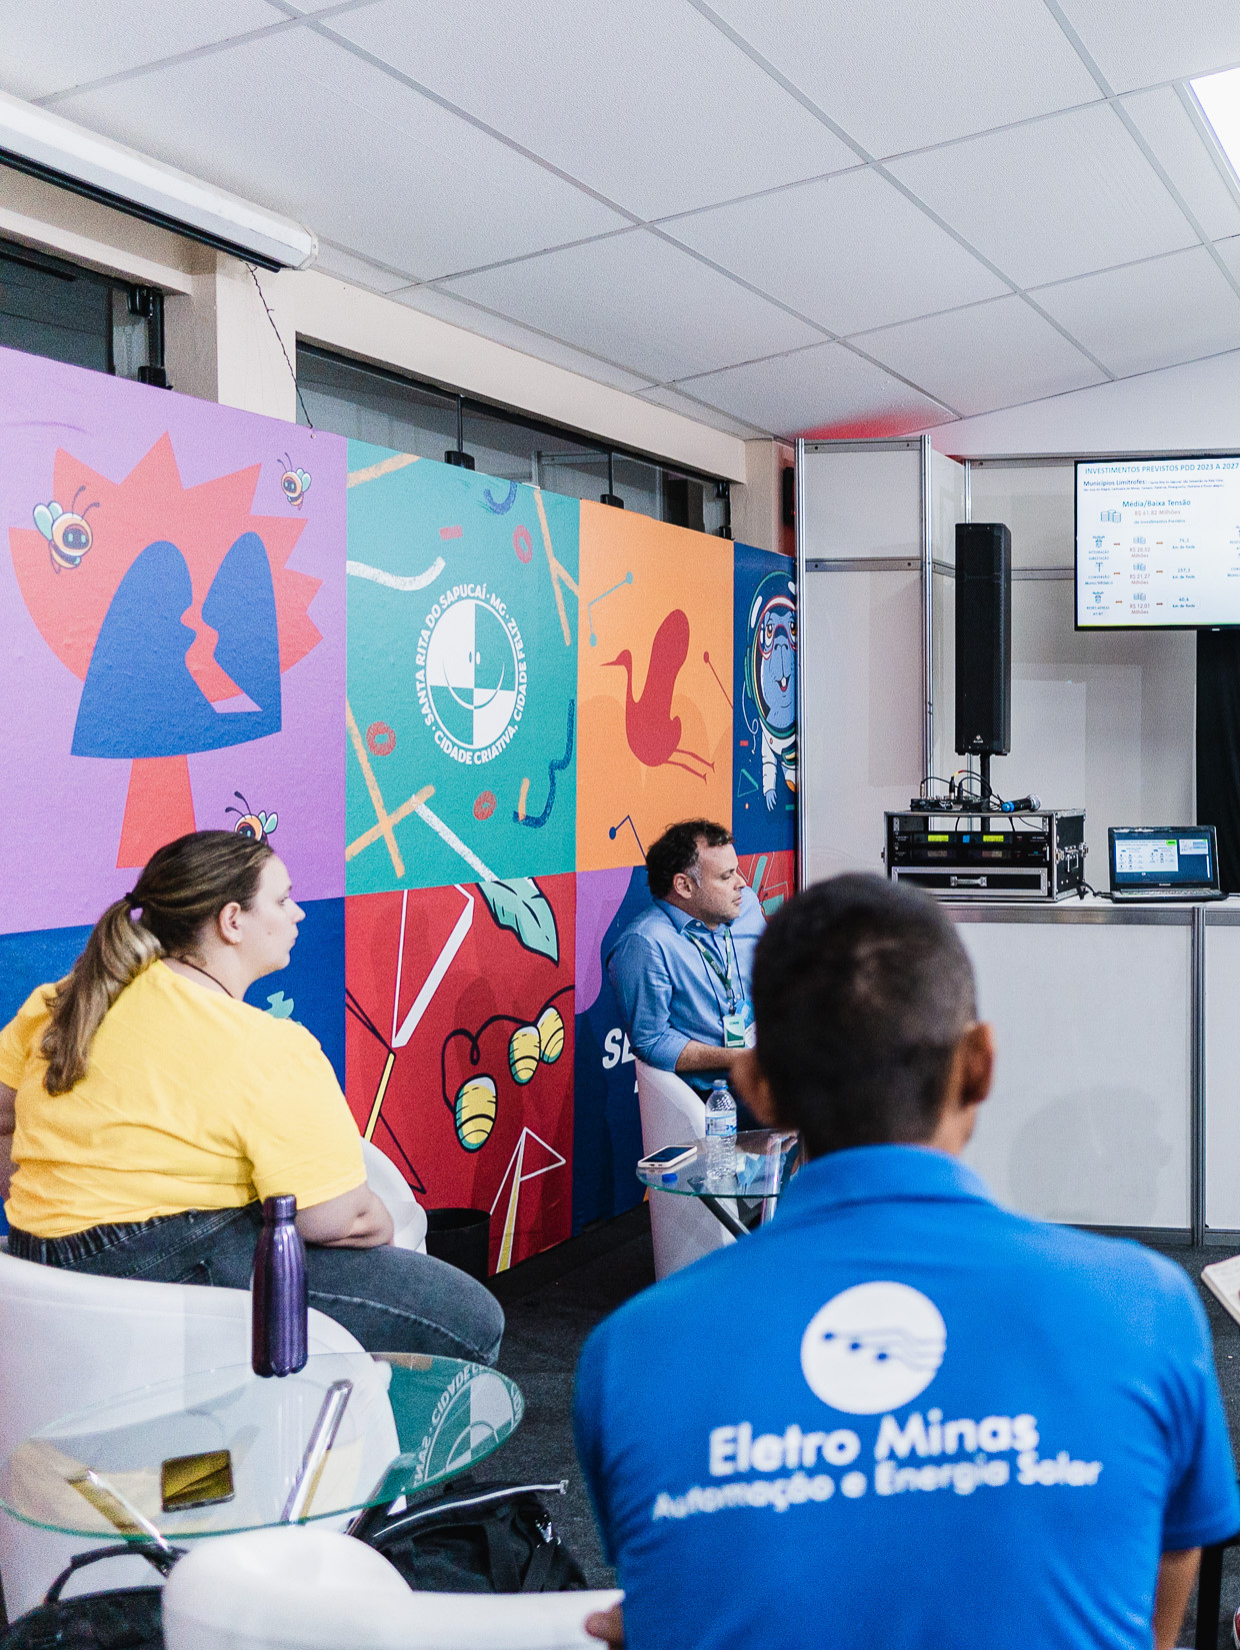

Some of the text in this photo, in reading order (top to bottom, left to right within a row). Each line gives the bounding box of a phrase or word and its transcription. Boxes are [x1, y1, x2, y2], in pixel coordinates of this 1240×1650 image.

[1122, 500, 1166, 508] Média/Baixa
[415, 583, 507, 726] SANTA RITA DO SAPUCAÍ MG
[507, 617, 525, 660] FELIZ
[514, 661, 527, 721] CIDADE
[434, 729, 473, 765] CIDADE
[708, 1407, 1040, 1478] Eletro Minas
[652, 1450, 1103, 1521] Automação e Energia Solar
